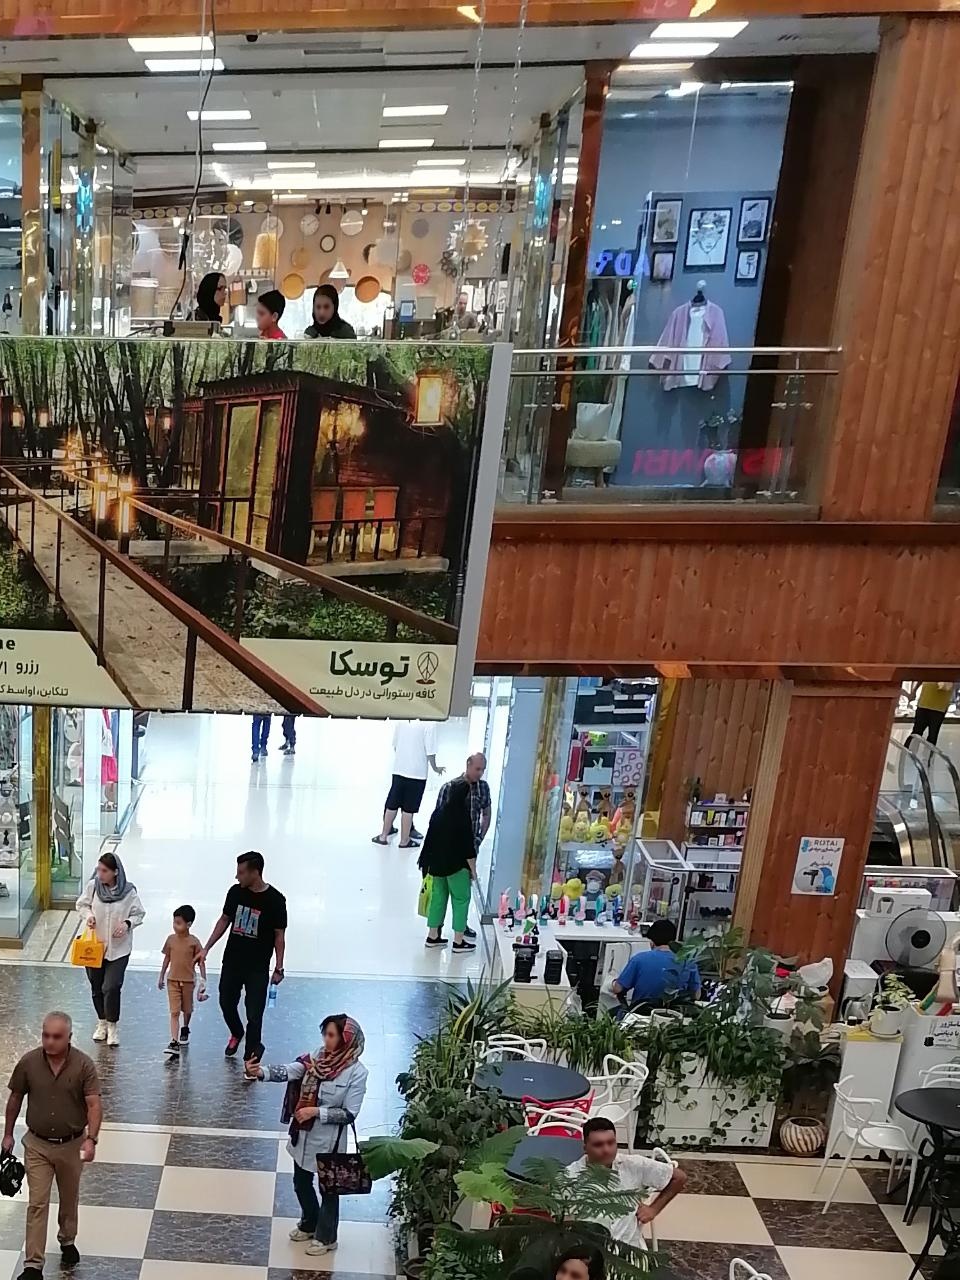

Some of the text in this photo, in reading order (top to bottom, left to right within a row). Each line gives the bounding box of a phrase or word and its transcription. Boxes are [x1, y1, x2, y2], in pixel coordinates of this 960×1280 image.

[16, 659, 39, 675] رزرو
[329, 649, 410, 686] توسکا
[7, 685, 36, 697] اواسط
[309, 686, 437, 700] کافه رستورانی در دل طبیعت
